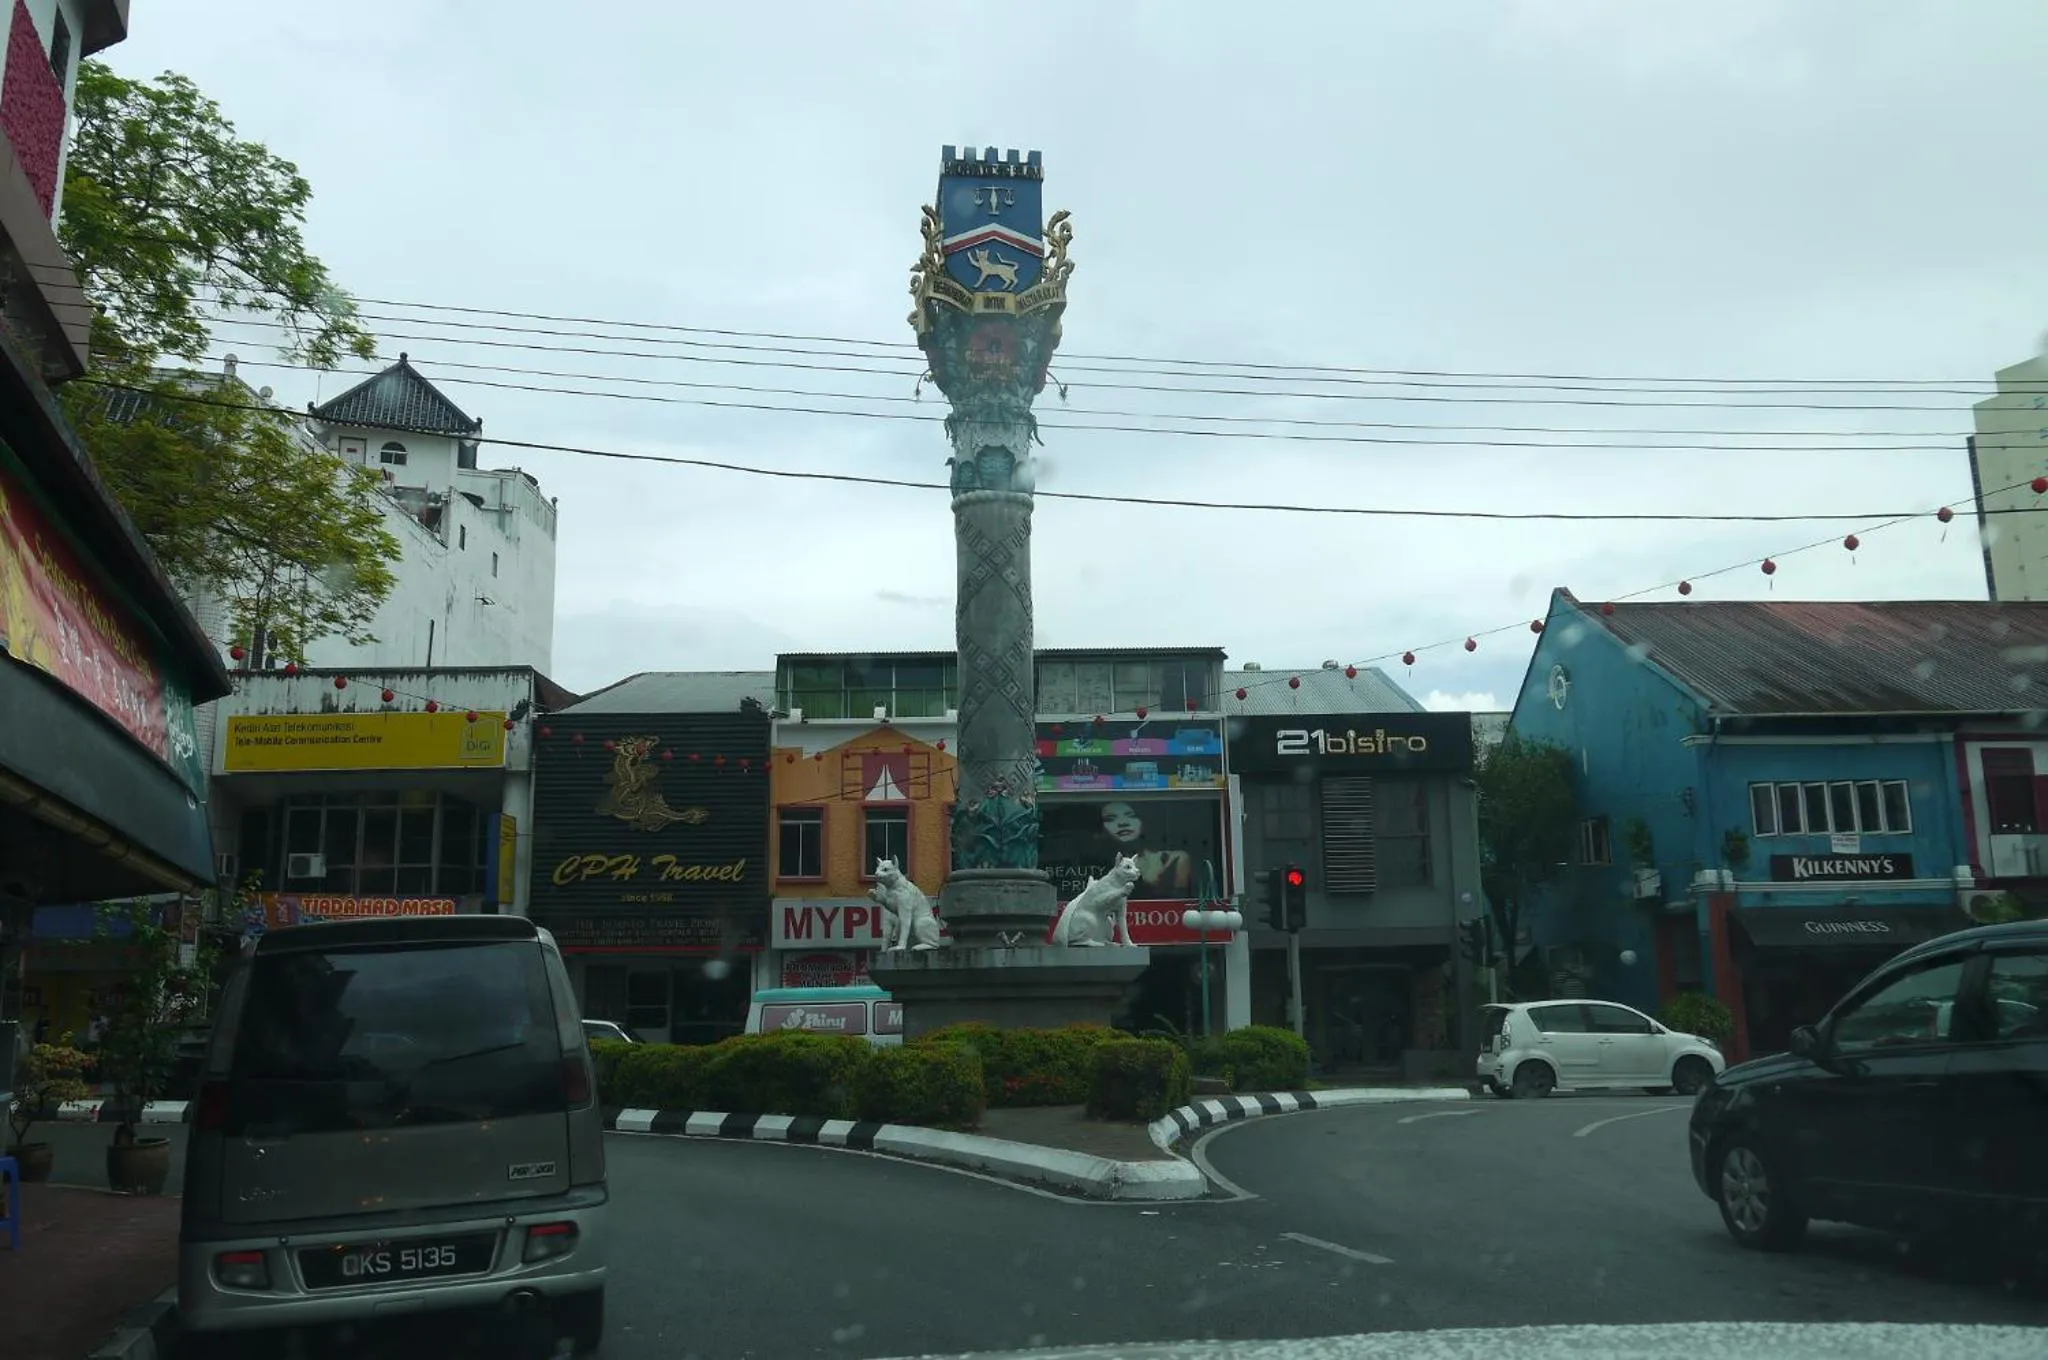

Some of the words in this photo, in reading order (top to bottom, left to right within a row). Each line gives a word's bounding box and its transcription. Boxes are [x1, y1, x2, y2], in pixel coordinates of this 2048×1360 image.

[285, 735, 351, 745] Communication
[353, 734, 382, 744] Centre
[552, 853, 641, 886] CPH
[651, 854, 747, 882] Travel
[1792, 856, 1895, 878] KILKENNY'S
[302, 897, 358, 915] TIADA
[359, 897, 400, 915] HAD
[402, 898, 455, 915] MASA
[1804, 921, 1890, 934] GUINNESS
[400, 1244, 457, 1271] 5135
